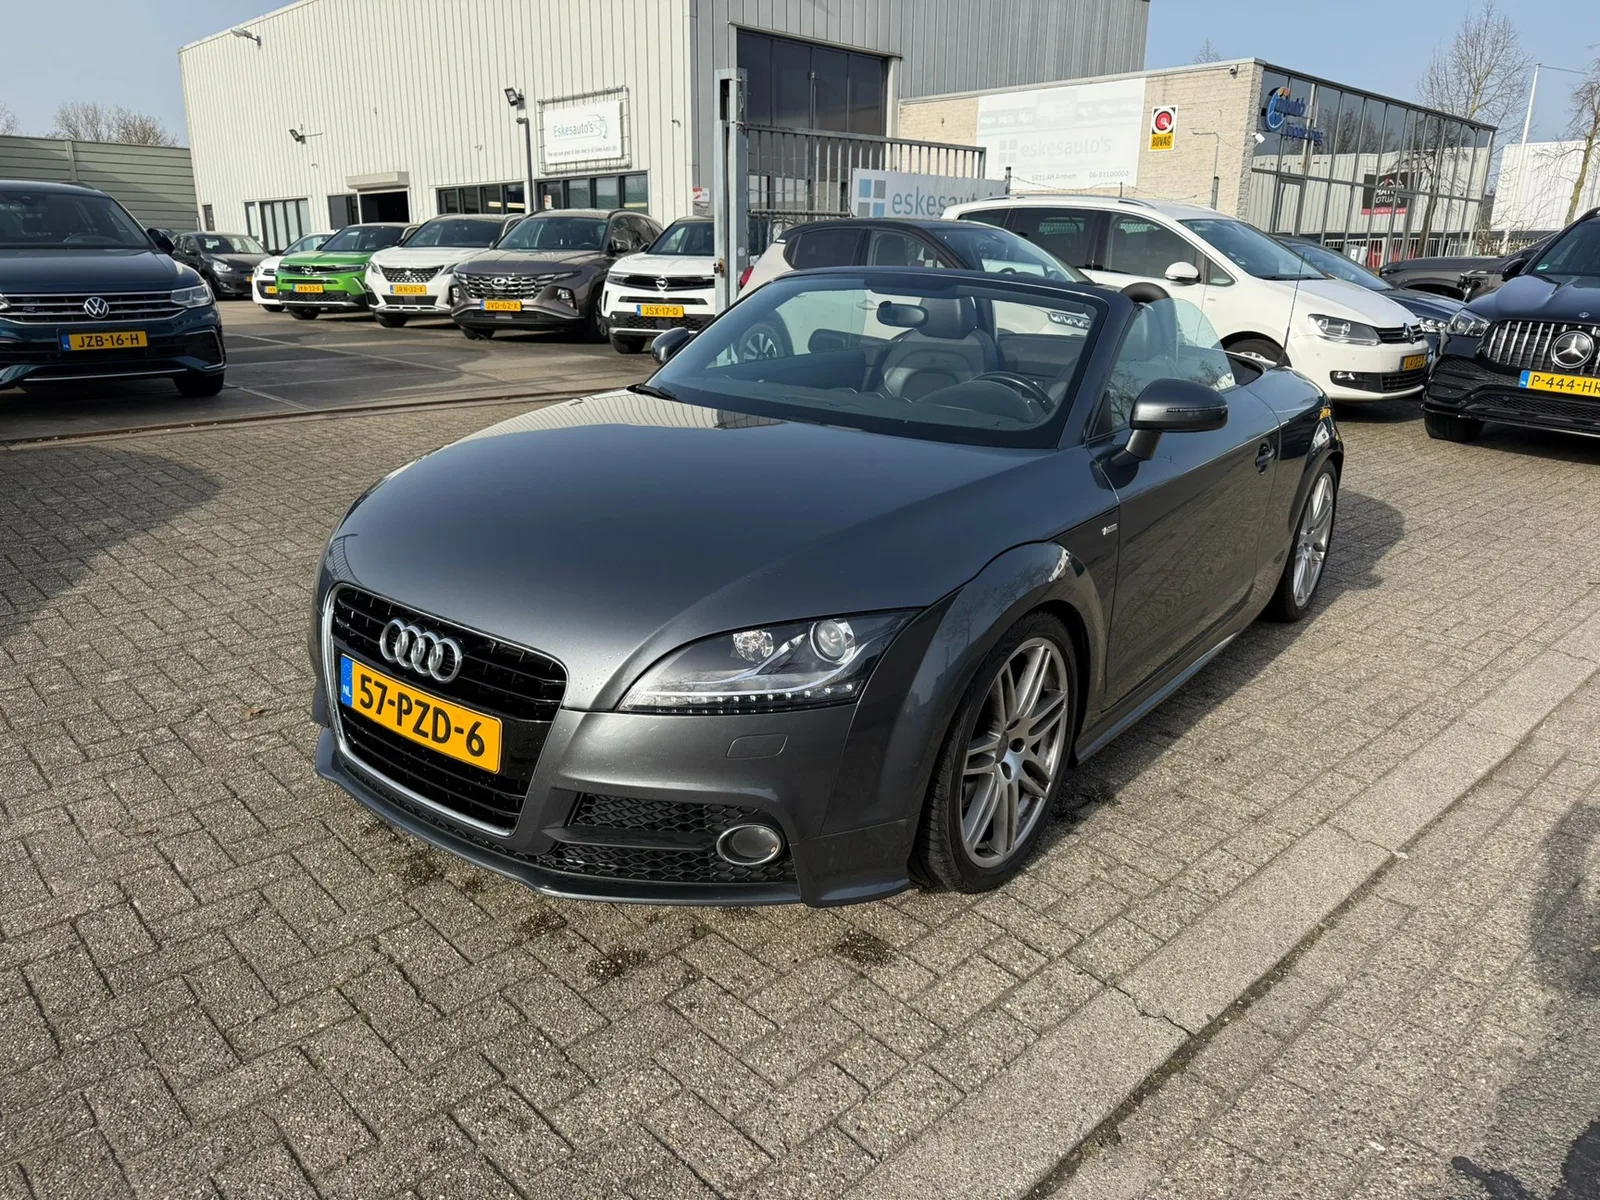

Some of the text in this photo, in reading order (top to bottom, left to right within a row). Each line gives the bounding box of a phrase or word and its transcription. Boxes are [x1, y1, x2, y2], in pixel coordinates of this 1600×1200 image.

[553, 120, 594, 138] Eskesauto's
[1021, 136, 1112, 158] eskesauto's
[1151, 135, 1172, 147] BOVAG
[486, 302, 519, 310] JVD-62-X
[645, 306, 679, 316] JSX-17-D
[78, 333, 140, 348] JZB-16-H
[342, 673, 485, 757] NL 57-PZD-6
